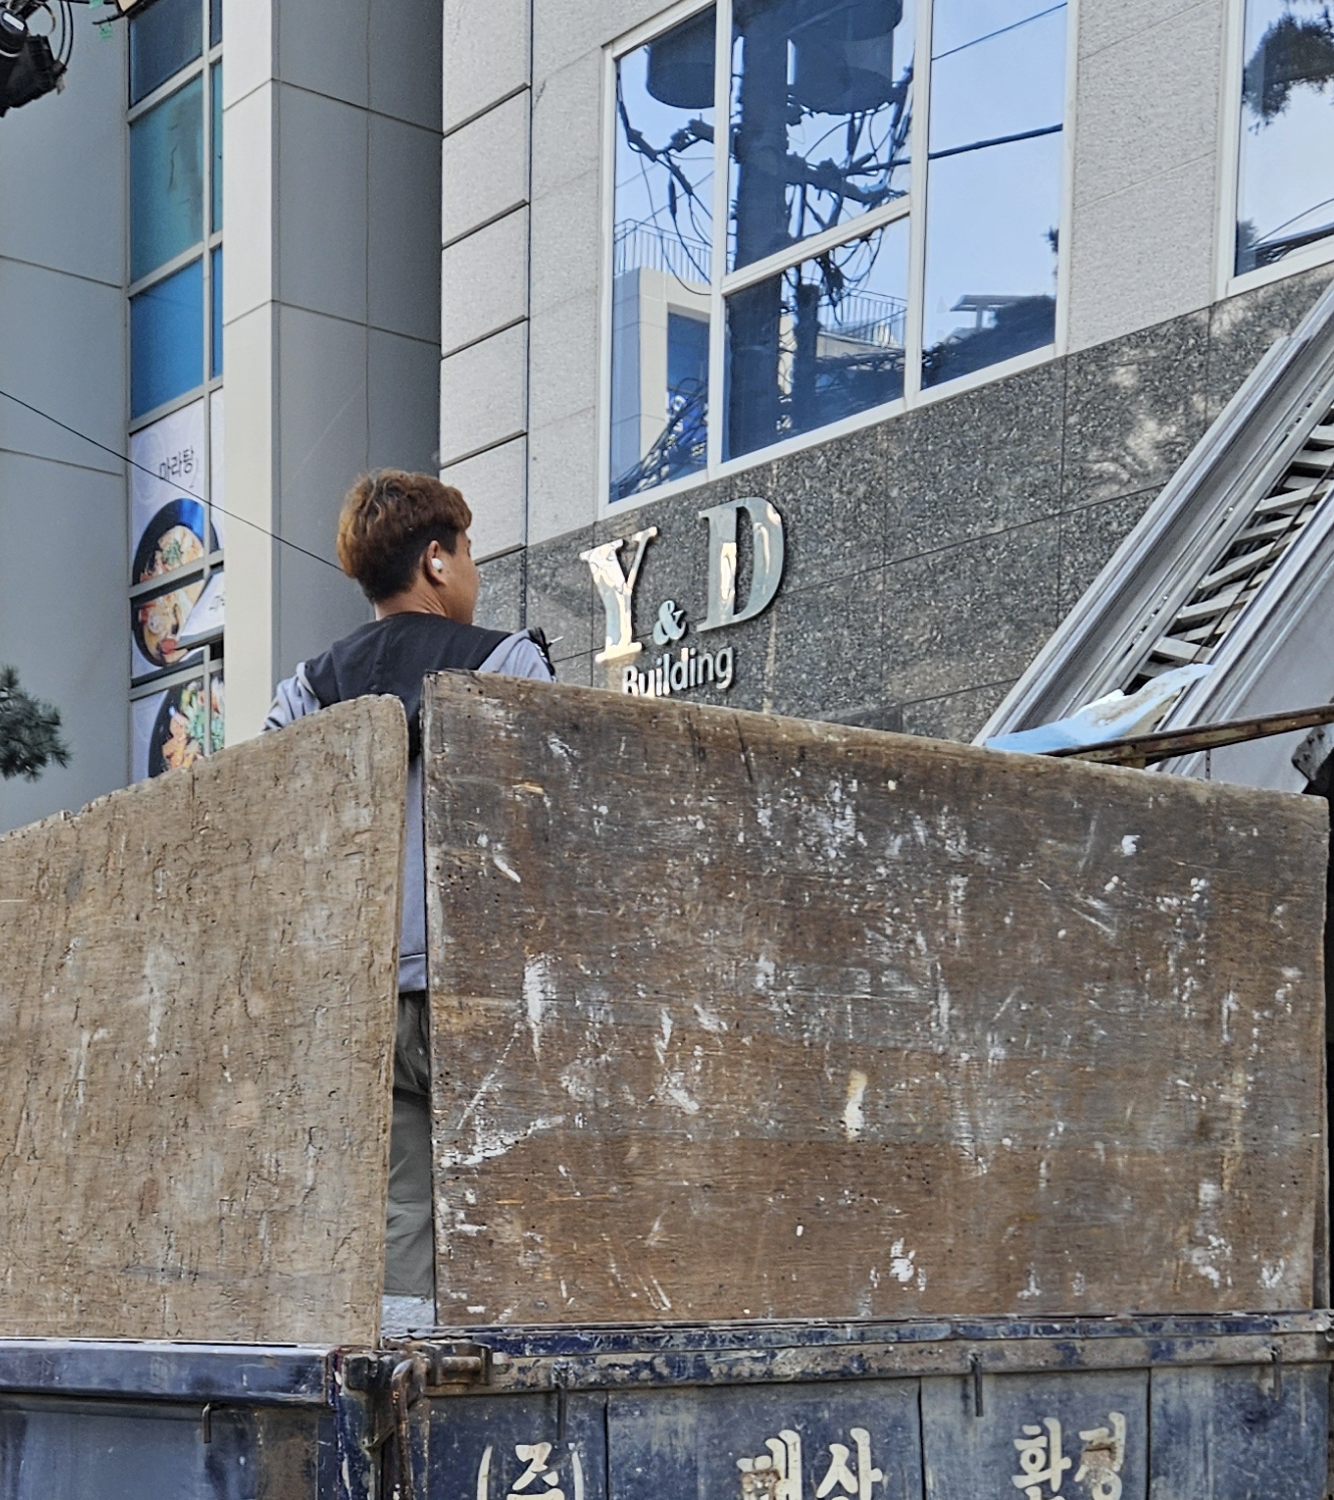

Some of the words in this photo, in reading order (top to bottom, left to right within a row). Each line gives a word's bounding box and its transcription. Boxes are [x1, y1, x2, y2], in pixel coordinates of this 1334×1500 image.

[579, 527, 658, 663] Y
[696, 497, 784, 632] D
[622, 647, 734, 697] Building
